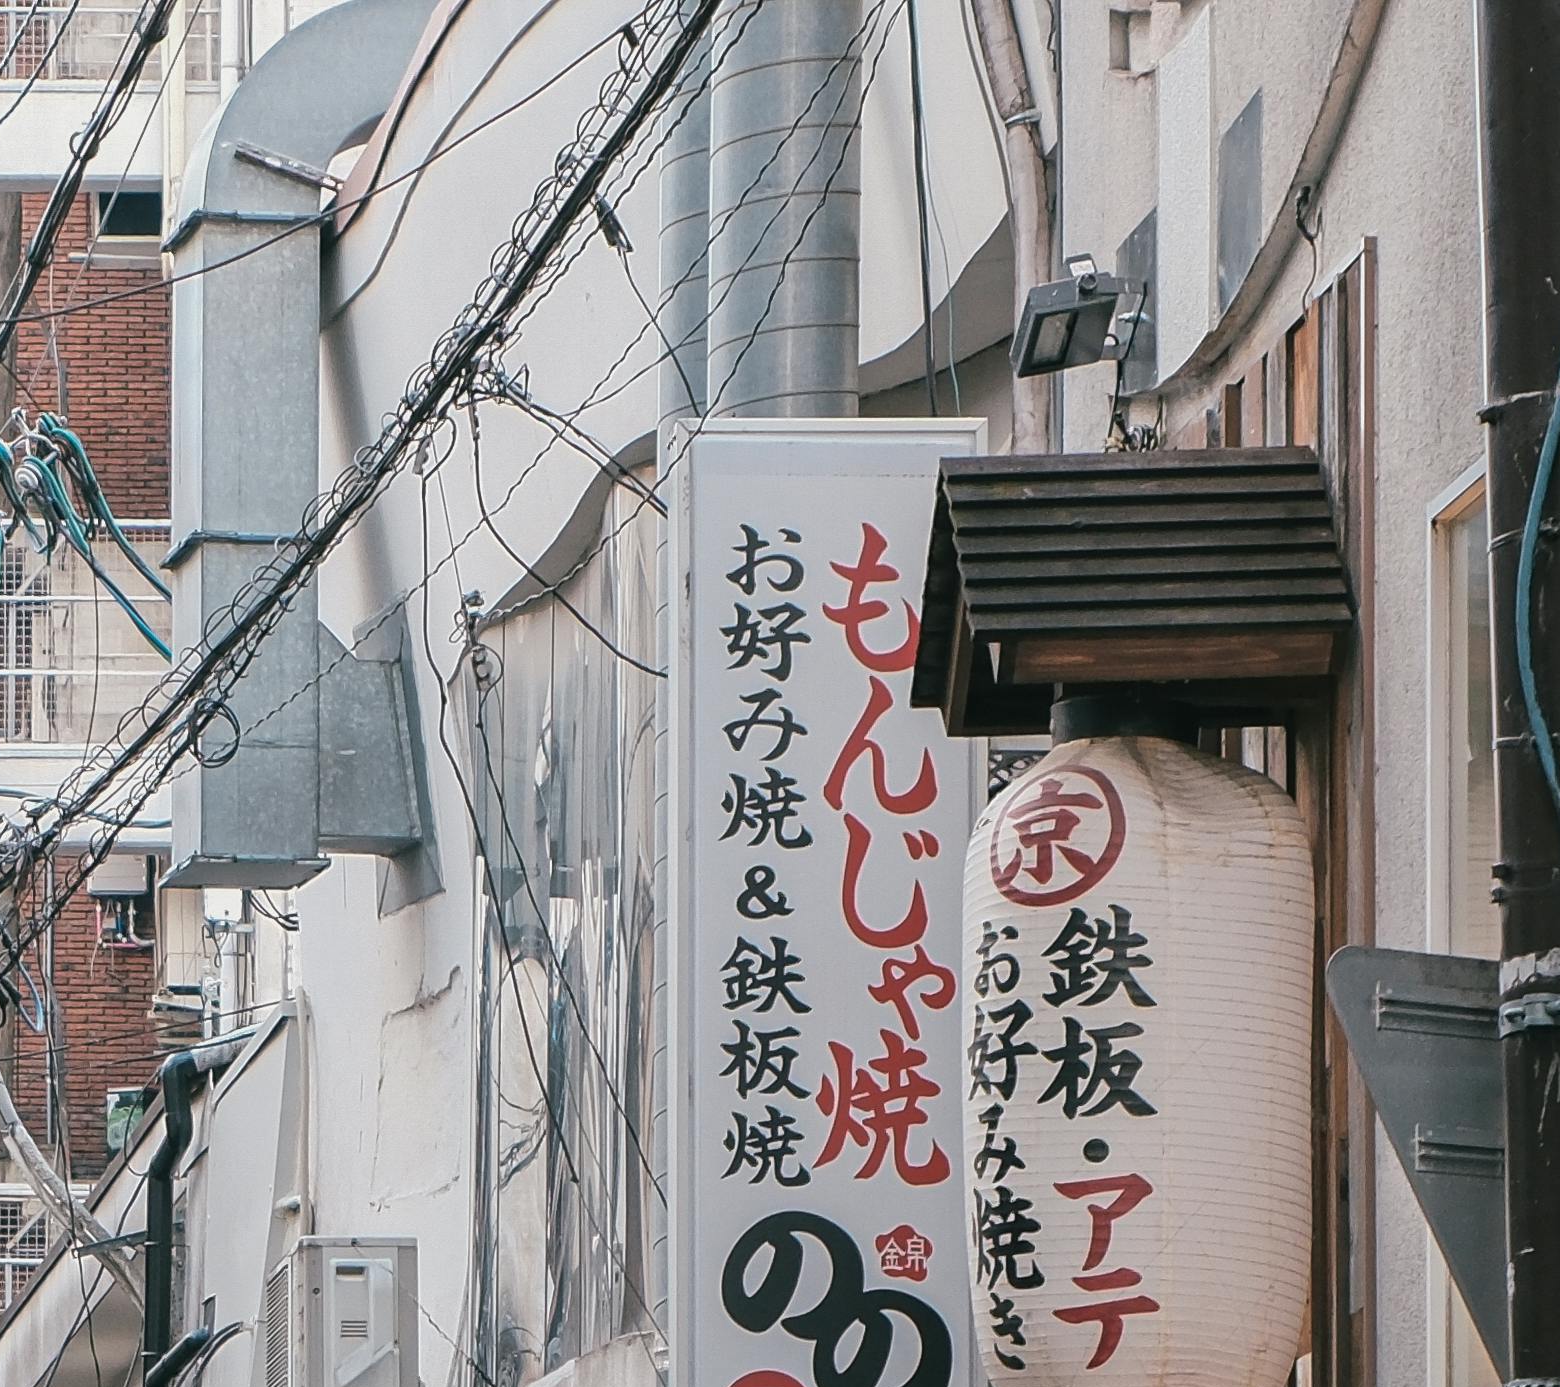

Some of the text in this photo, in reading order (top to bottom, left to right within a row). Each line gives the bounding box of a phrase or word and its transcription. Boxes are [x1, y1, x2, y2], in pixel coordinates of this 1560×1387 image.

[719, 524, 813, 1188] お好み焼&鉄板焼
[812, 522, 958, 1187] もんじゃ焼
[966, 918, 1046, 1373] お好み焼き
[1037, 904, 1161, 1371] 鉄板・アテ
